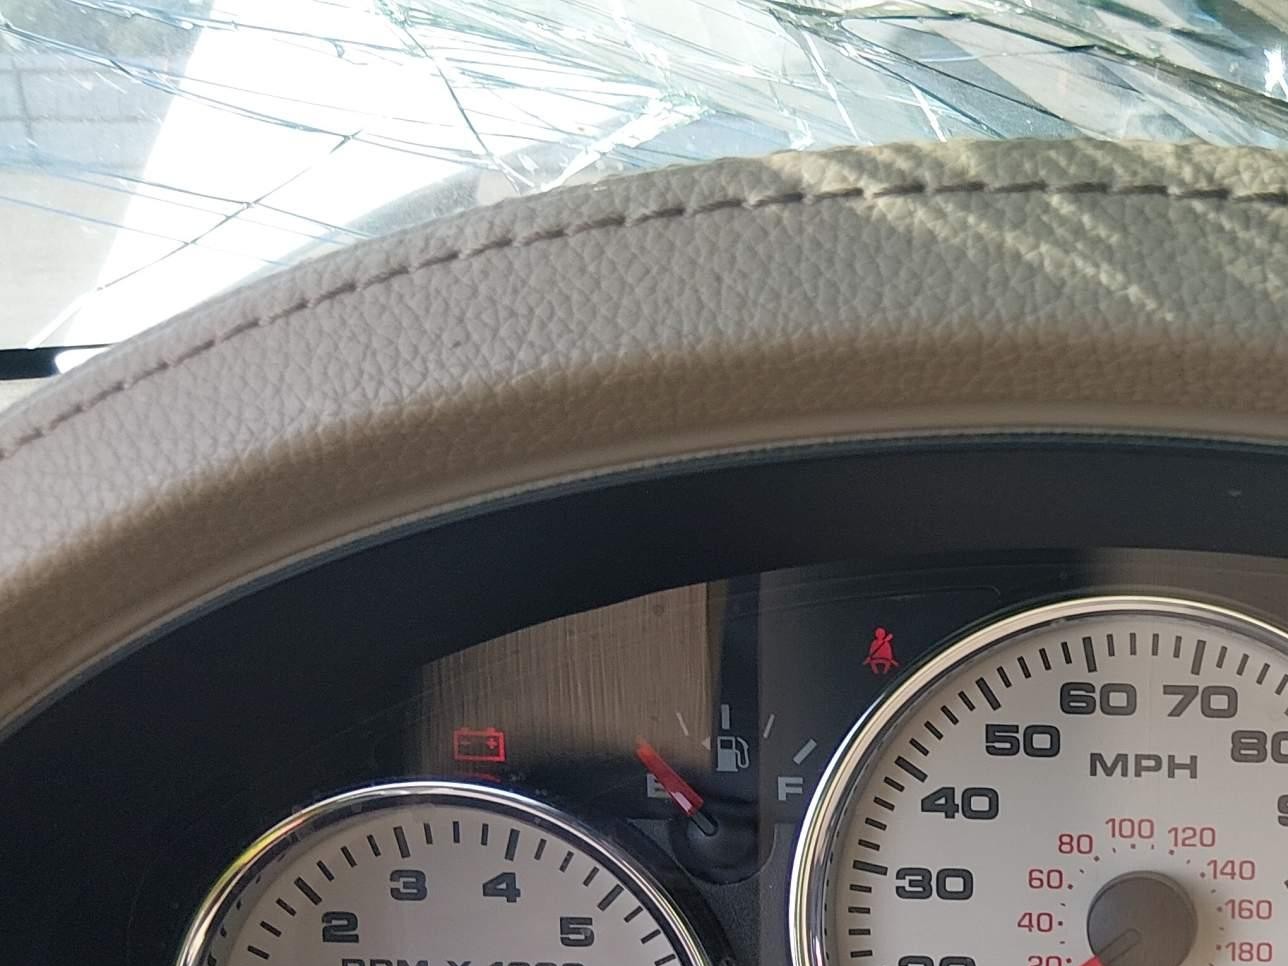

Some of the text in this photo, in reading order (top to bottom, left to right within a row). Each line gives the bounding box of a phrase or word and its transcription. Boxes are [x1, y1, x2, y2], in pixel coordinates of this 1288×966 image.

[1059, 681, 1137, 716] 60
[1162, 684, 1239, 719] 70
[985, 723, 1061, 758] 50
[1089, 752, 1199, 780] MPH
[777, 776, 804, 801] F
[920, 786, 1000, 821] 40
[1106, 817, 1155, 840] 100
[1167, 826, 1217, 849] 120
[1057, 832, 1094, 855] 80
[895, 867, 974, 901] 30
[1027, 867, 1065, 890] 60
[1207, 858, 1257, 882] 140
[389, 869, 428, 902] 3
[482, 871, 521, 904] 4
[1016, 911, 1055, 934] 40
[1225, 898, 1273, 920] 160
[321, 911, 360, 944] 2
[559, 916, 595, 948] 5
[1226, 942, 1273, 963] 180
